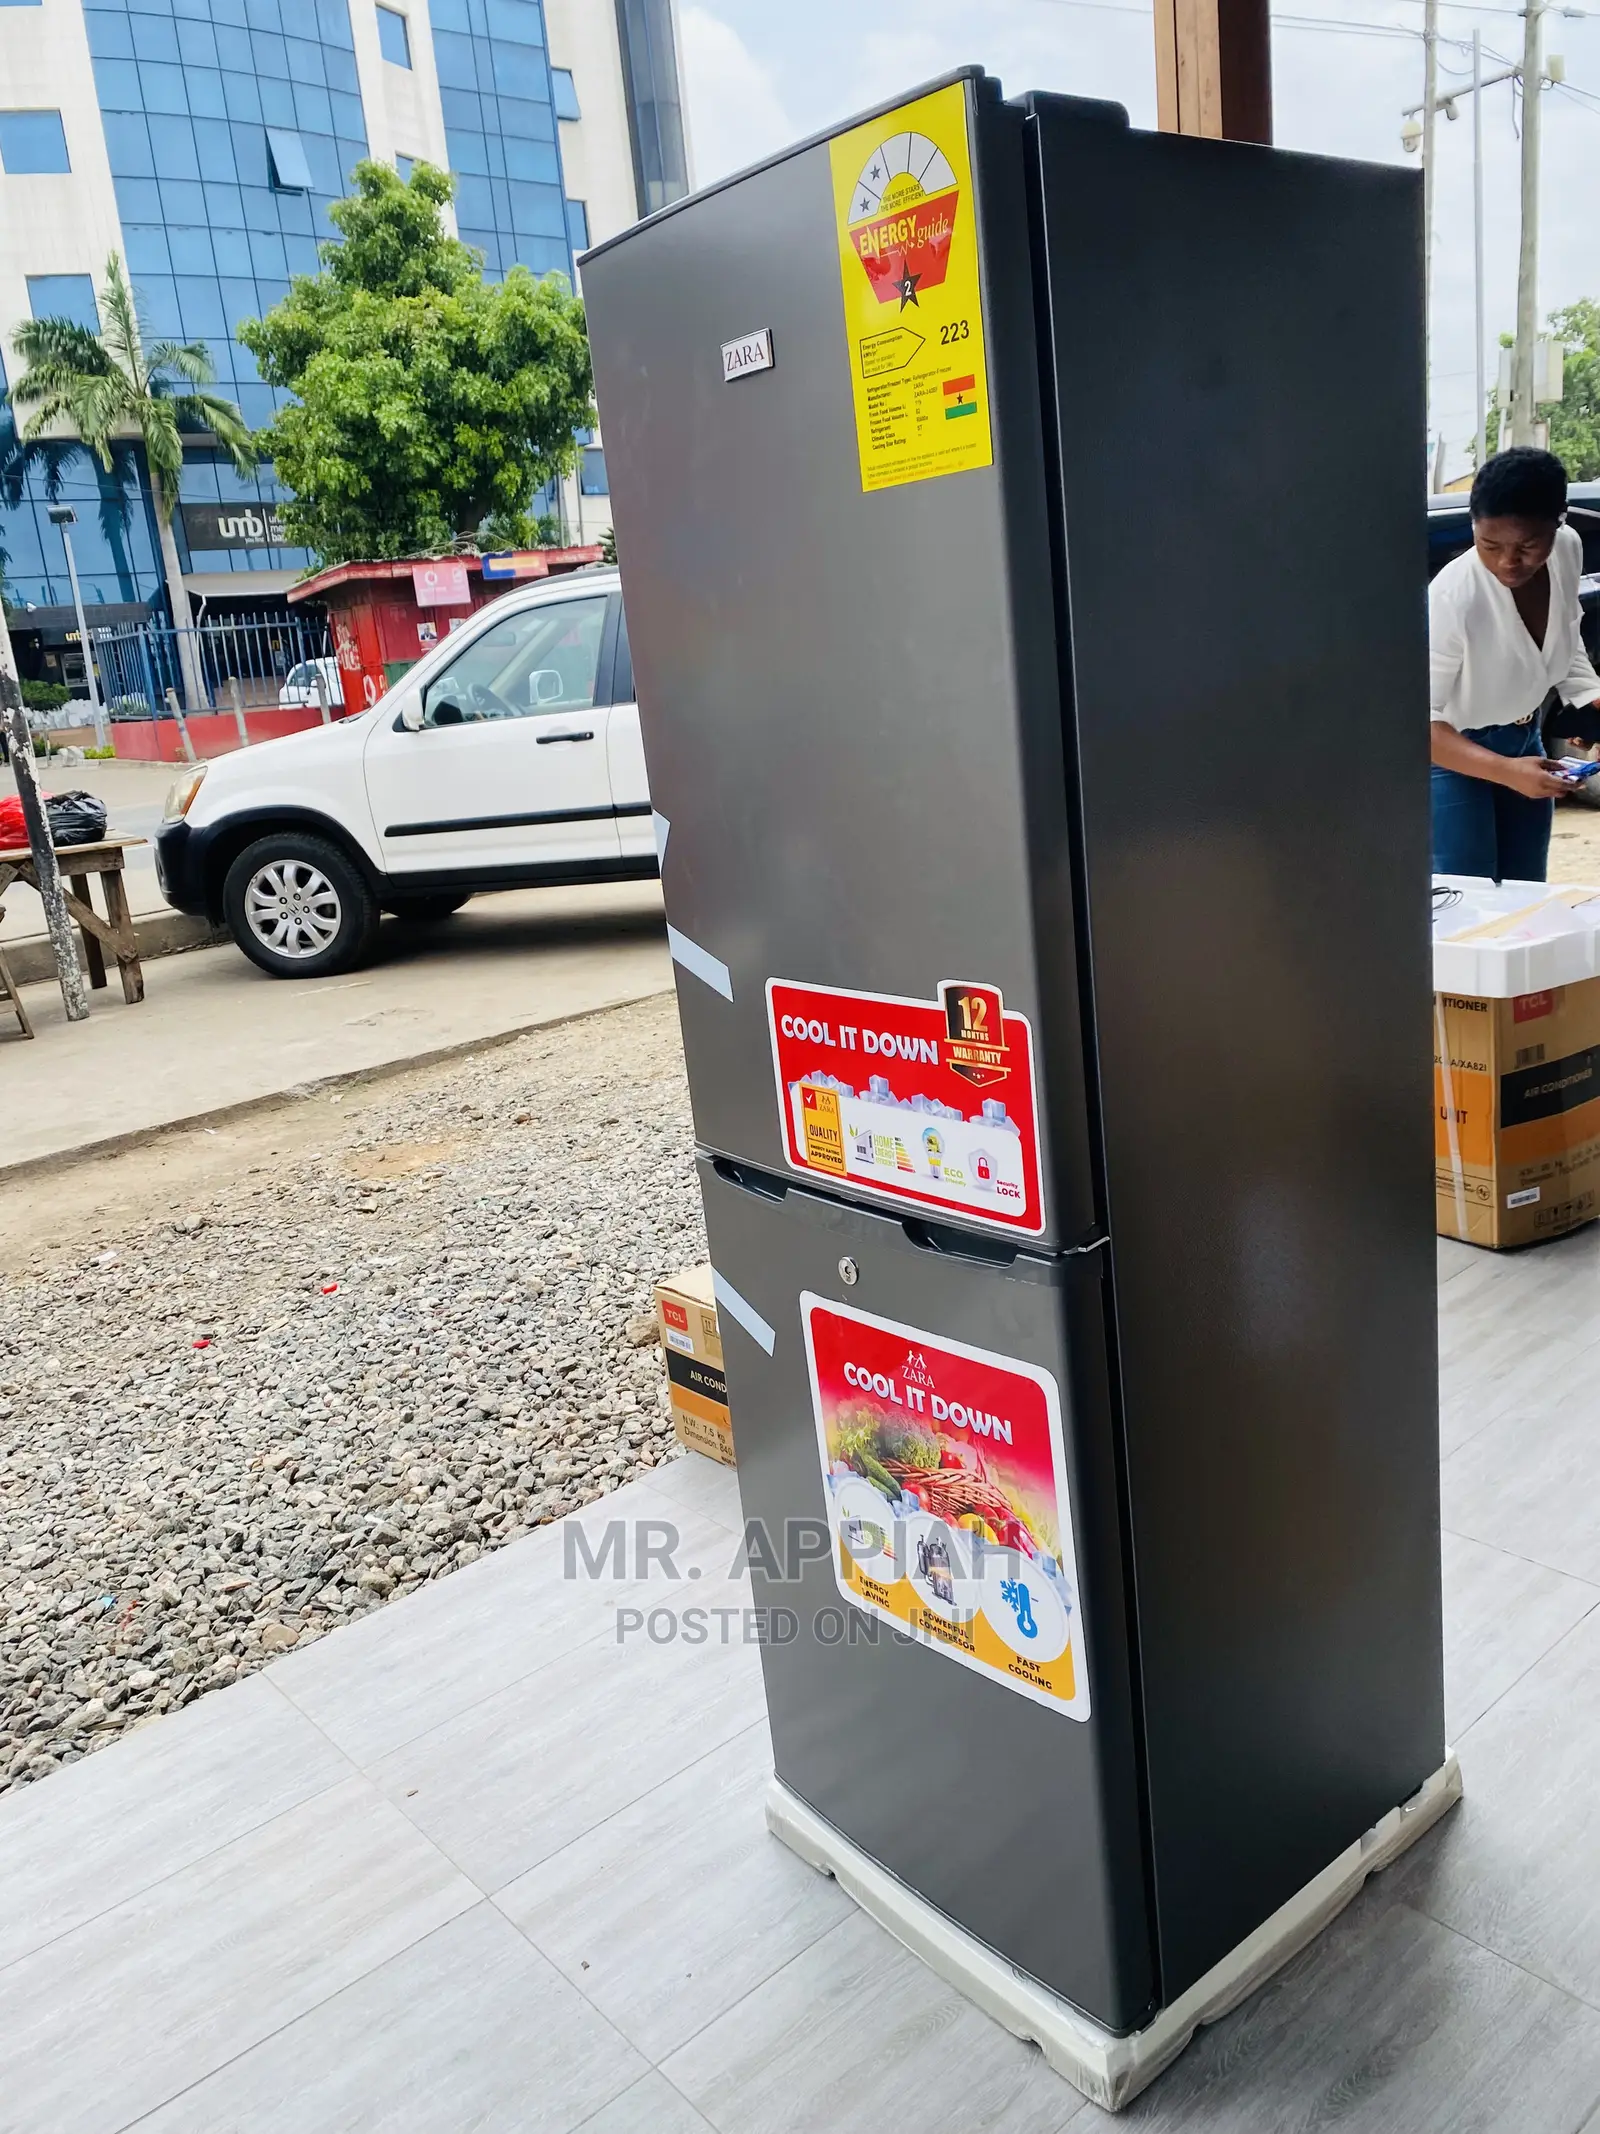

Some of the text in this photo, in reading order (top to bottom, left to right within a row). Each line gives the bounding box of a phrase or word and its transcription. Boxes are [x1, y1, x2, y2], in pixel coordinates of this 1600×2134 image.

[860, 214, 948, 259] ENERGY guide
[904, 280, 912, 296] 2
[940, 320, 970, 346] 223
[725, 342, 765, 372] ZARA
[218, 508, 264, 538] umb
[1519, 993, 1548, 1010] TCL
[958, 996, 988, 1032] 12
[780, 1013, 939, 1066] COOL IT DOWN
[961, 1030, 990, 1042] MONTHS
[952, 1046, 1002, 1064] WARRANTY
[1524, 1068, 1593, 1100] AIR CONDITIONER
[1440, 1106, 1468, 1124] UIT
[809, 1124, 838, 1142] QUALITY
[873, 1134, 894, 1150] HOME
[810, 1150, 842, 1164] APPROVED
[944, 1168, 964, 1178] ECO
[996, 1180, 1018, 1189] Security
[996, 1186, 1021, 1199] LOCK
[666, 1308, 684, 1324] TCL
[690, 1370, 704, 1384] AIR
[901, 1365, 936, 1390] ZARA
[843, 1361, 1014, 1446] COOL IT DOWN
[717, 1431, 726, 1444] kg
[860, 1576, 889, 1598] ENERGY
[922, 1610, 970, 1640] POWERFUL
[919, 1618, 976, 1653] COMPRESSOR
[1016, 1656, 1042, 1673] FAST
[1008, 1664, 1053, 1690] COOLING
